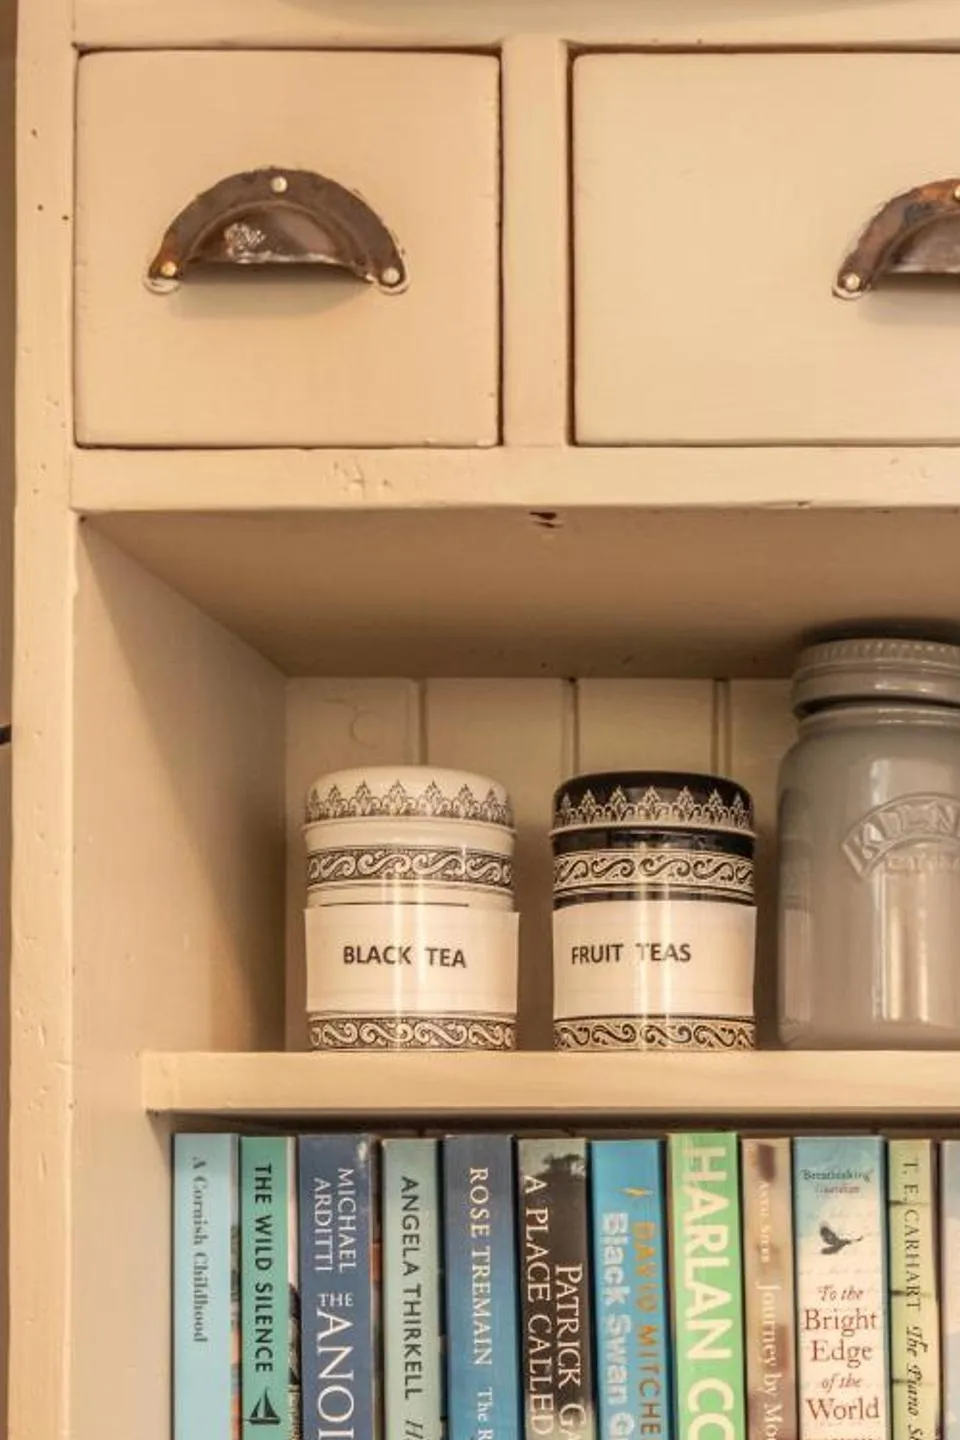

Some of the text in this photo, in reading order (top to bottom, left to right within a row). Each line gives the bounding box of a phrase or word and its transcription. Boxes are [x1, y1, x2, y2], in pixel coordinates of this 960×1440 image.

[343, 946, 467, 968] BLACK TEA
[571, 943, 691, 965] FRUIT TEAS
[313, 1177, 333, 1272] ARDITTI
[335, 1167, 356, 1273] MICHAEL
[523, 1174, 546, 1194] A
[192, 1156, 209, 1343] A Cornish Childhood
[254, 1163, 273, 1373] THE WILD SILENCE
[400, 1176, 424, 1400] ANGELA THIRKELL
[468, 1167, 493, 1366] ROSE TREMAIN
[525, 1207, 549, 1301] PLACE
[601, 1212, 629, 1304] Black
[681, 1147, 734, 1359] HARLAN
[317, 1292, 354, 1306] THE
[552, 1264, 583, 1388] PATRICK
[756, 1281, 782, 1367] Journey
[805, 1308, 877, 1337] Bright
[906, 1326, 927, 1356] The
[528, 1313, 554, 1435] CALLED
[604, 1313, 632, 1405] Swan
[758, 1373, 783, 1397] by
[811, 1339, 873, 1369] Edge
[905, 1363, 924, 1416] Piano
[476, 1387, 494, 1421] The
[806, 1397, 880, 1420] World
